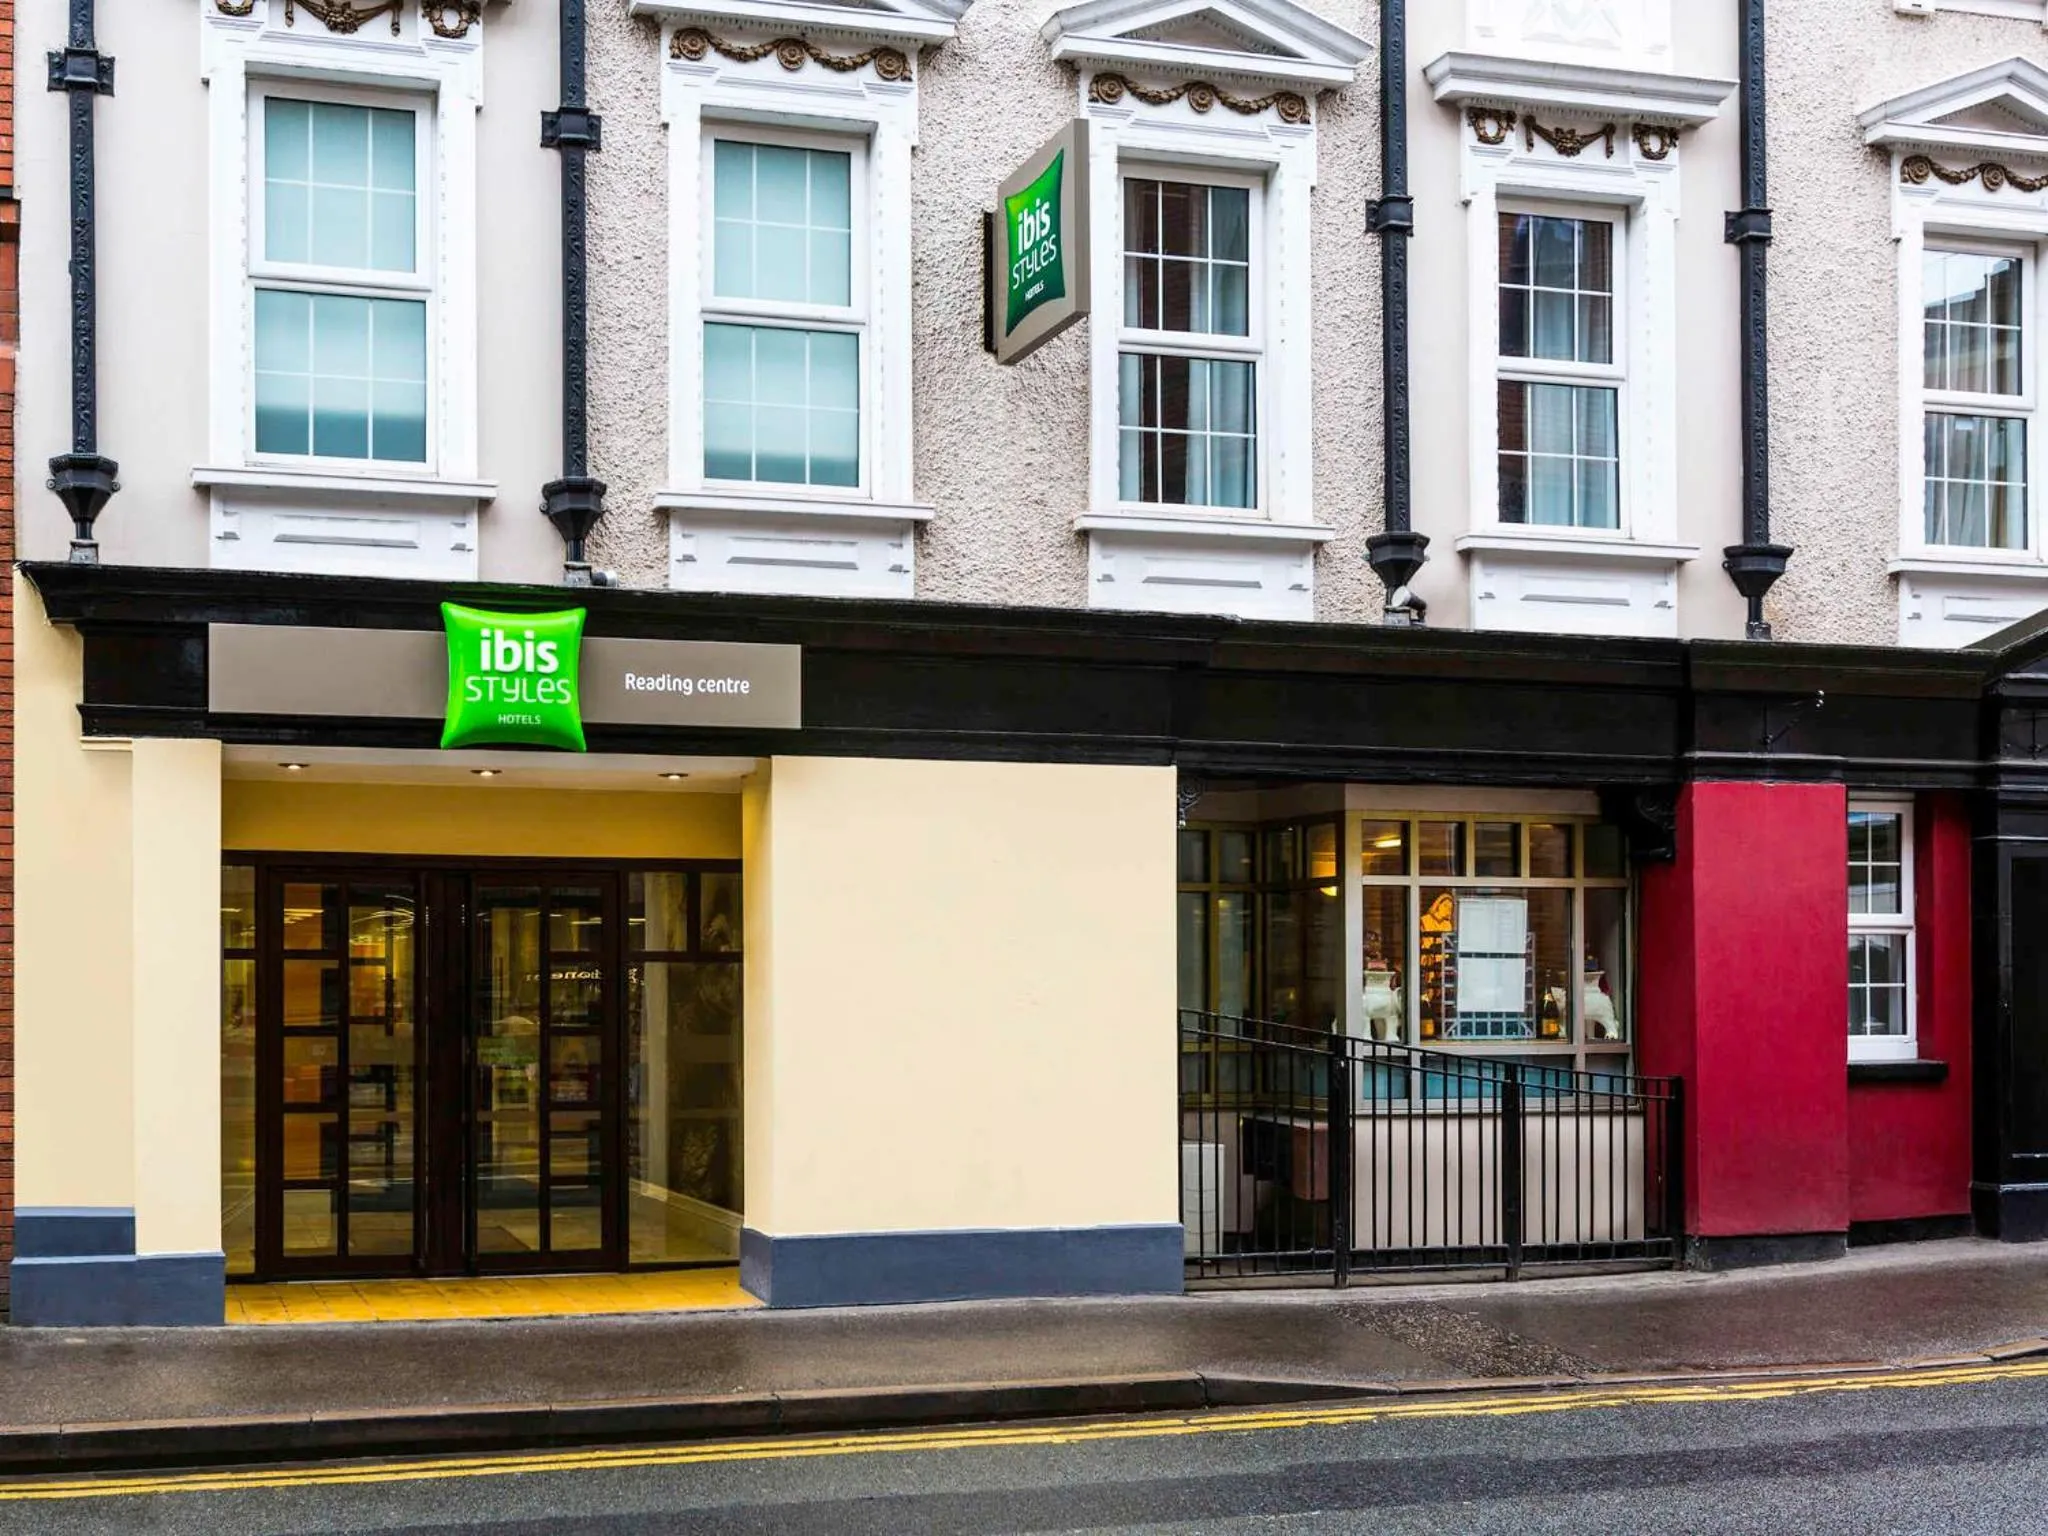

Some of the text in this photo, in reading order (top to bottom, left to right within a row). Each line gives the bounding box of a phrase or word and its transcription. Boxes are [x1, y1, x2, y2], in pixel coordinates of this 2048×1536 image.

[1018, 198, 1051, 255] ibis
[1024, 280, 1044, 301] HOTELS
[480, 628, 559, 674] ibis
[624, 672, 750, 696] Reading centre
[498, 714, 542, 725] HOTELS
